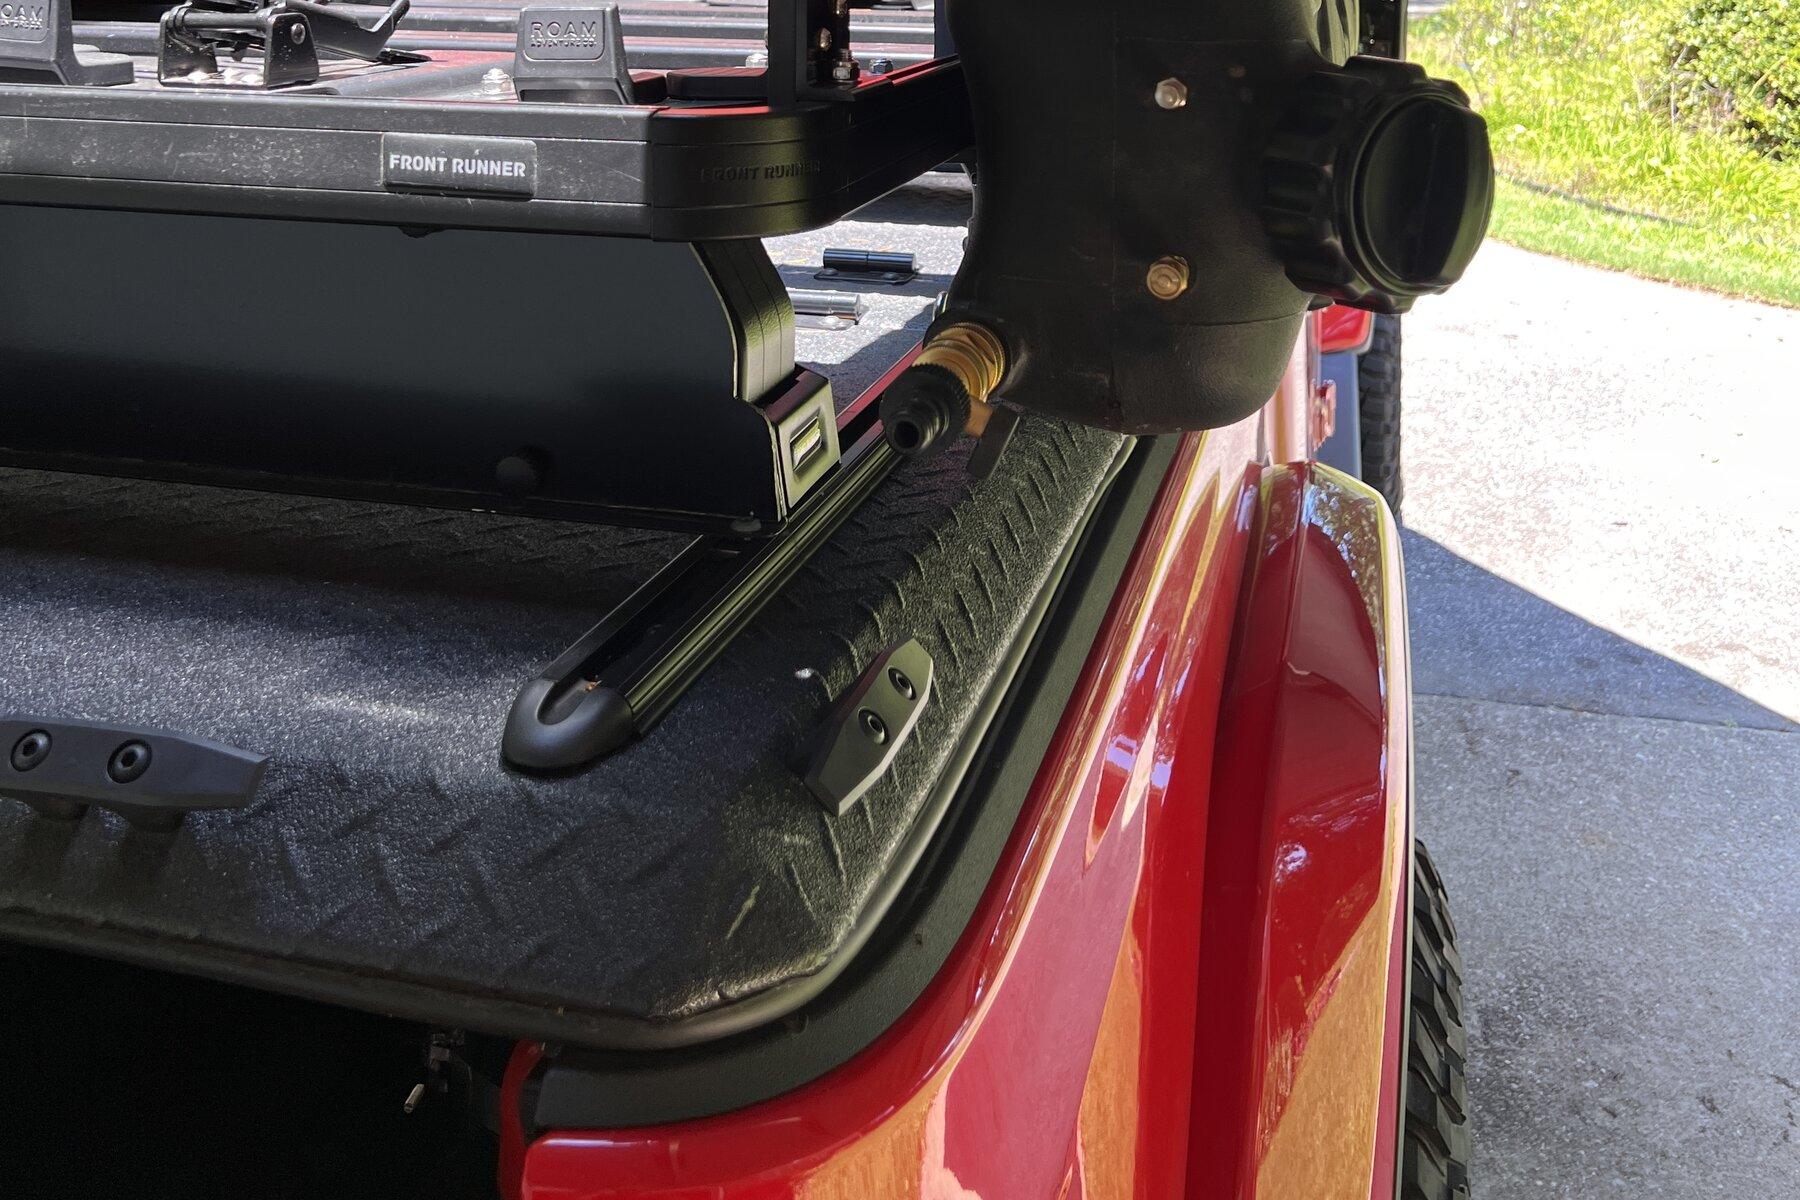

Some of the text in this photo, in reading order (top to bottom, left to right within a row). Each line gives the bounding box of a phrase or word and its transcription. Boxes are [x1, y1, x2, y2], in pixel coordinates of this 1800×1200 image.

[0, 3, 44, 21] OAM
[530, 21, 597, 38] ROAM
[389, 153, 527, 178] FRONT RUNNER
[699, 166, 761, 184] FRONT
